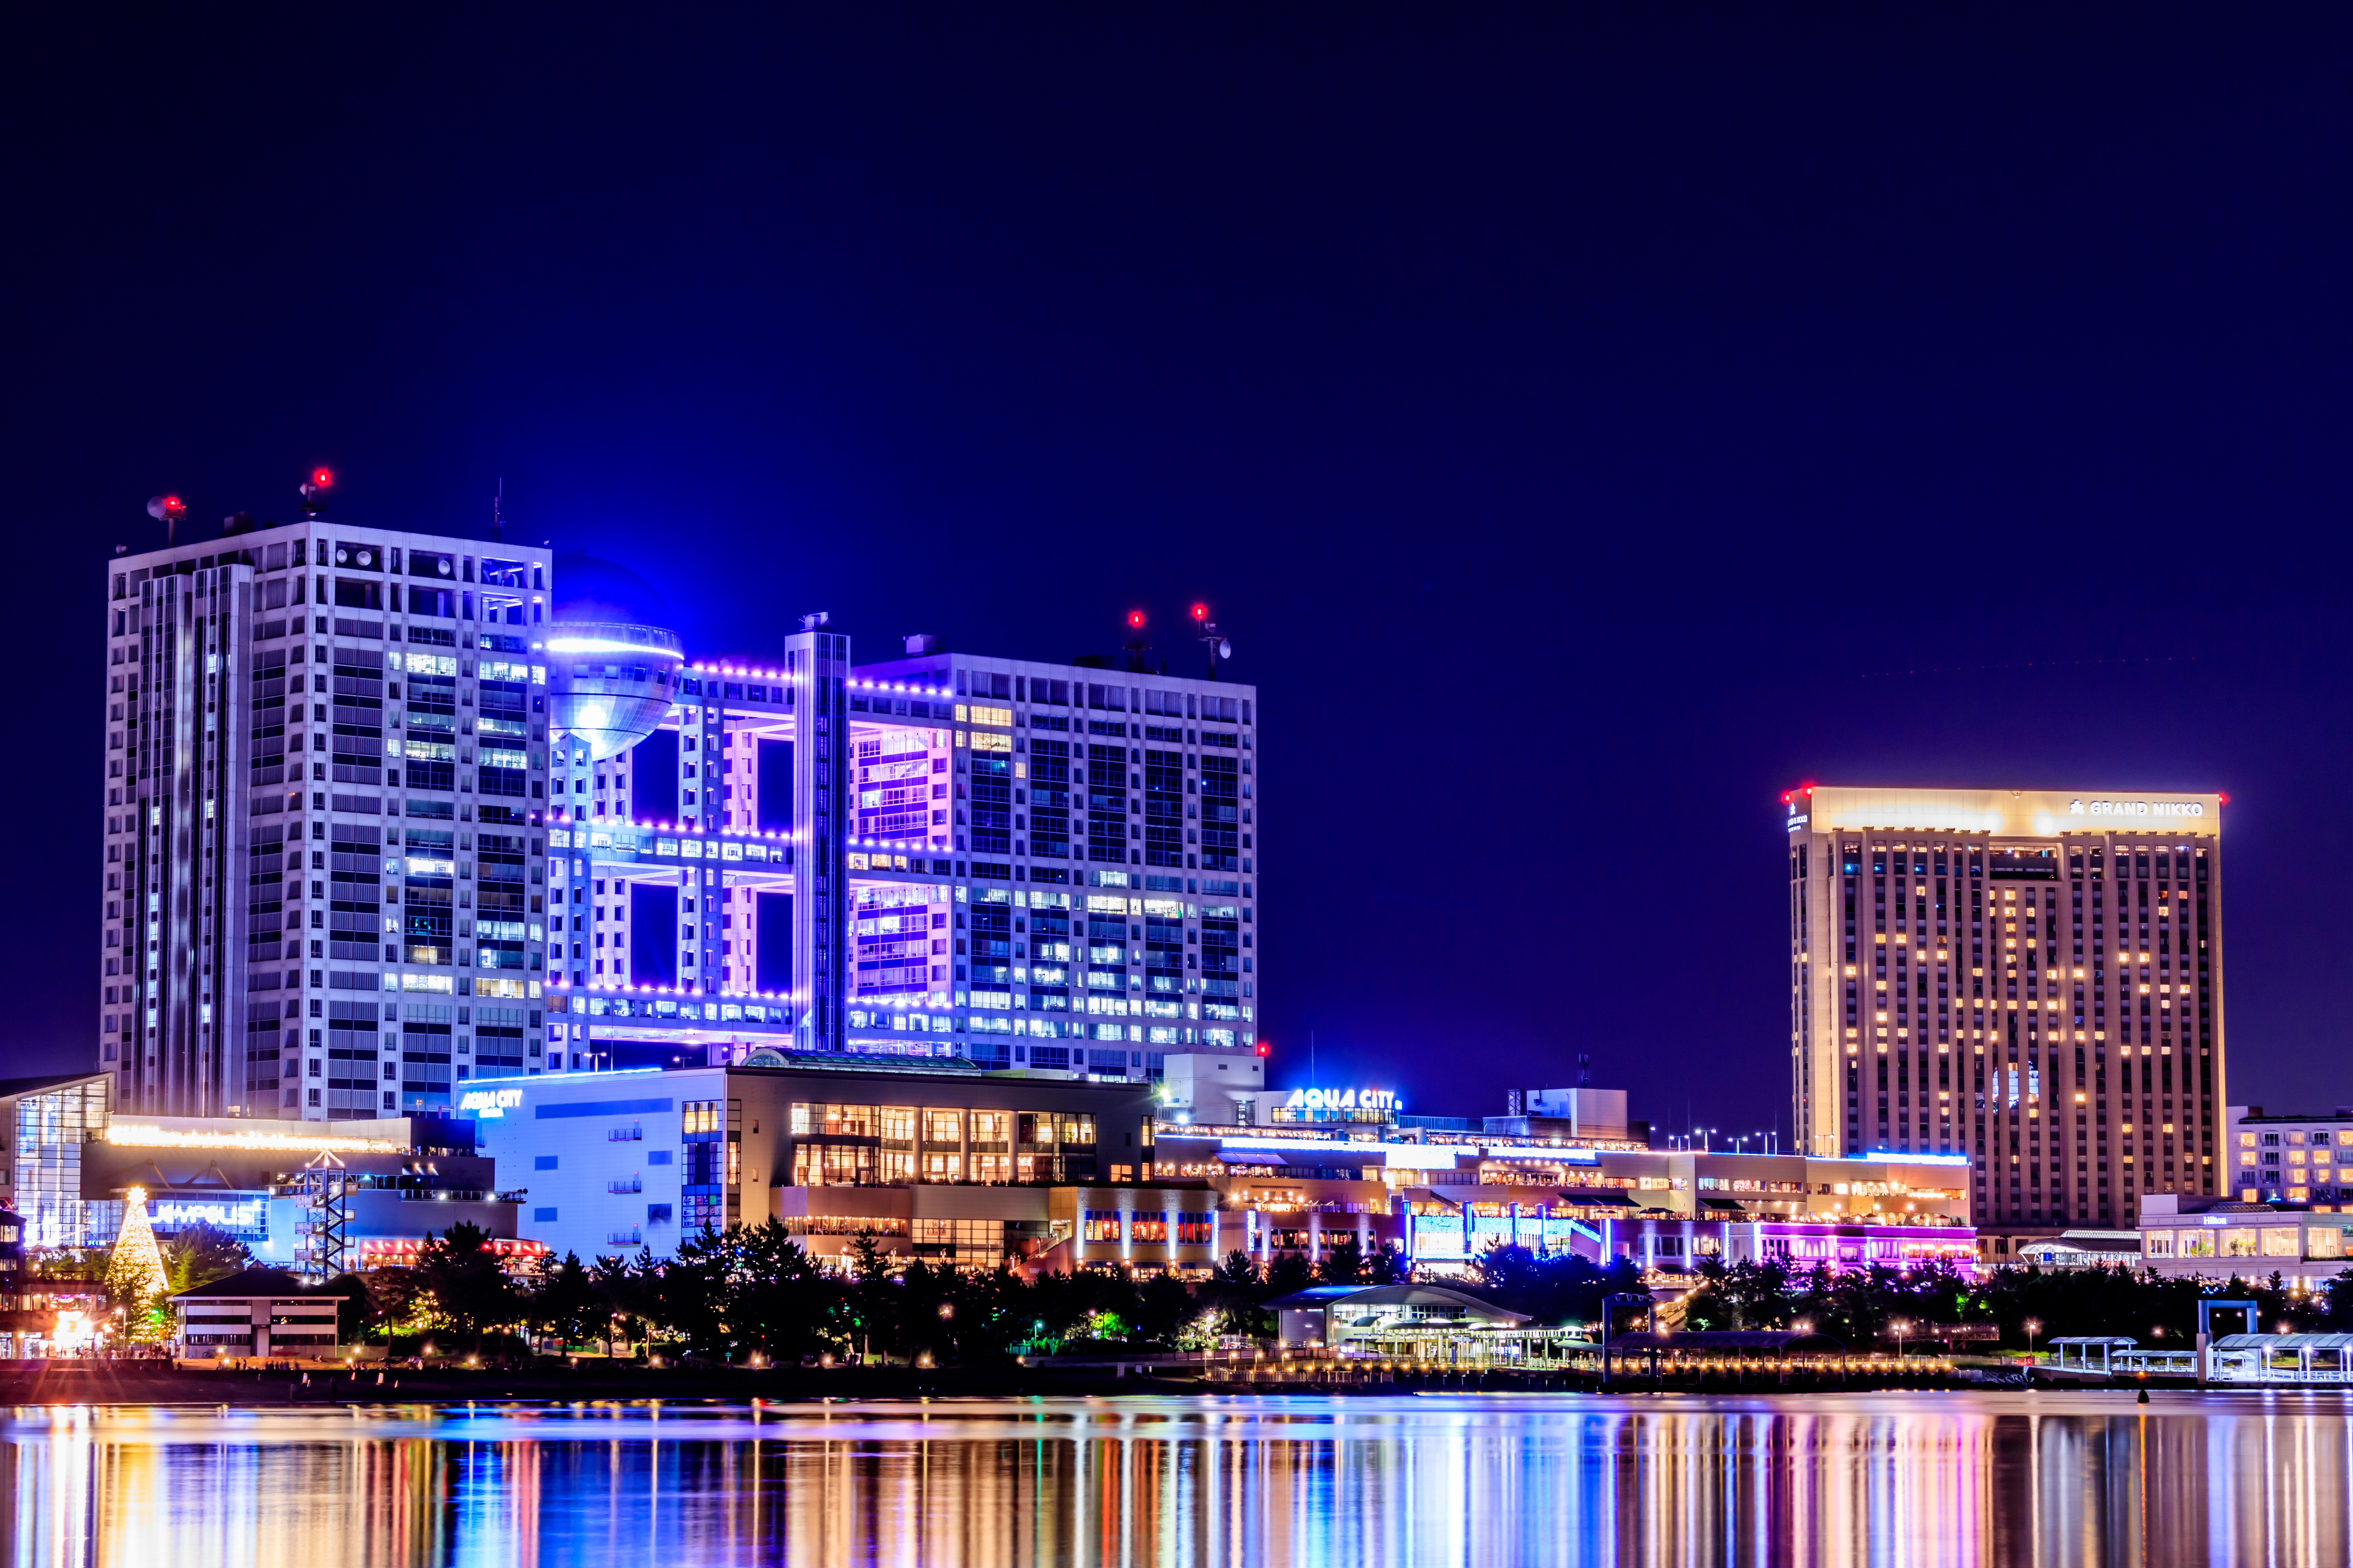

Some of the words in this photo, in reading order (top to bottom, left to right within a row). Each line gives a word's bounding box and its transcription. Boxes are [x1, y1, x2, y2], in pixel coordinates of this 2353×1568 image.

[2089, 801, 2148, 816] GRAND
[2153, 802, 2204, 817] NIKKO
[1287, 1089, 1355, 1108] AQUA
[2203, 1216, 2227, 1225] Hilton
